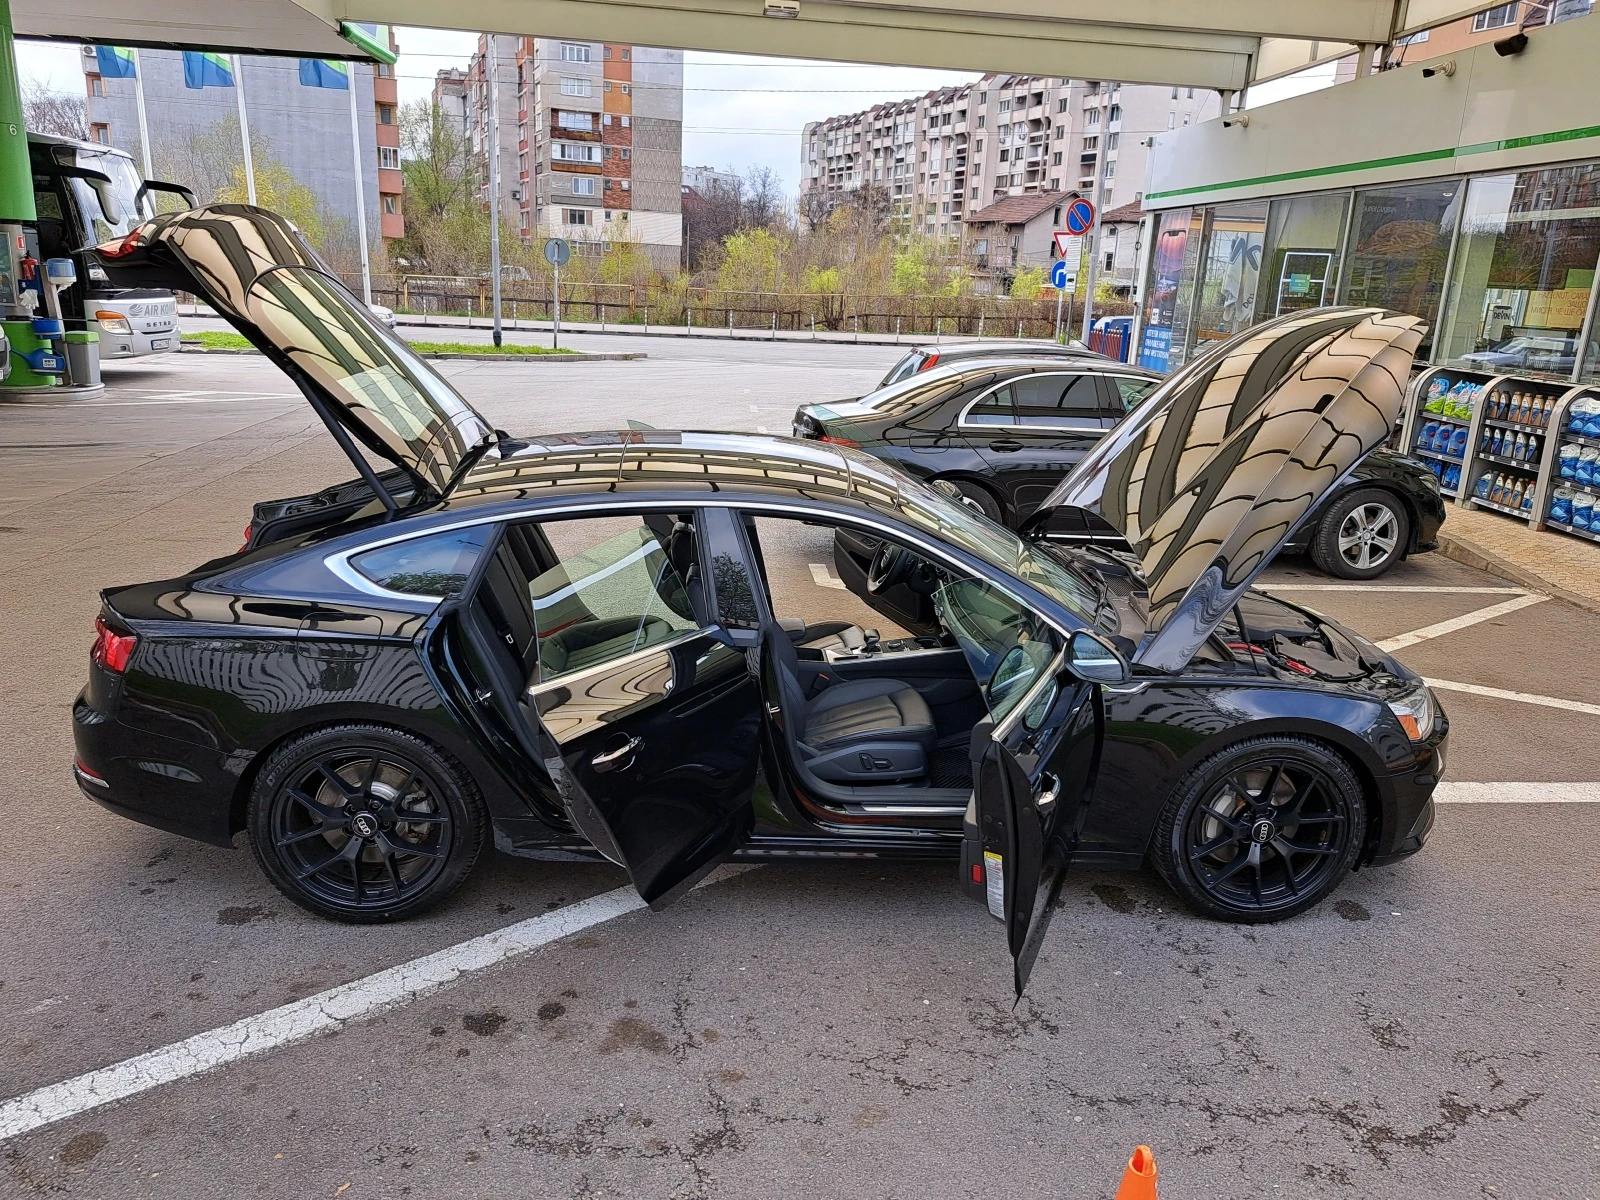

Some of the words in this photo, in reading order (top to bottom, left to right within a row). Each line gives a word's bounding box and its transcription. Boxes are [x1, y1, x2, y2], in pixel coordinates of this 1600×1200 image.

[10, 124, 17, 136] 6
[144, 304, 159, 316] AIR
[1493, 311, 1511, 321] DEVIN
